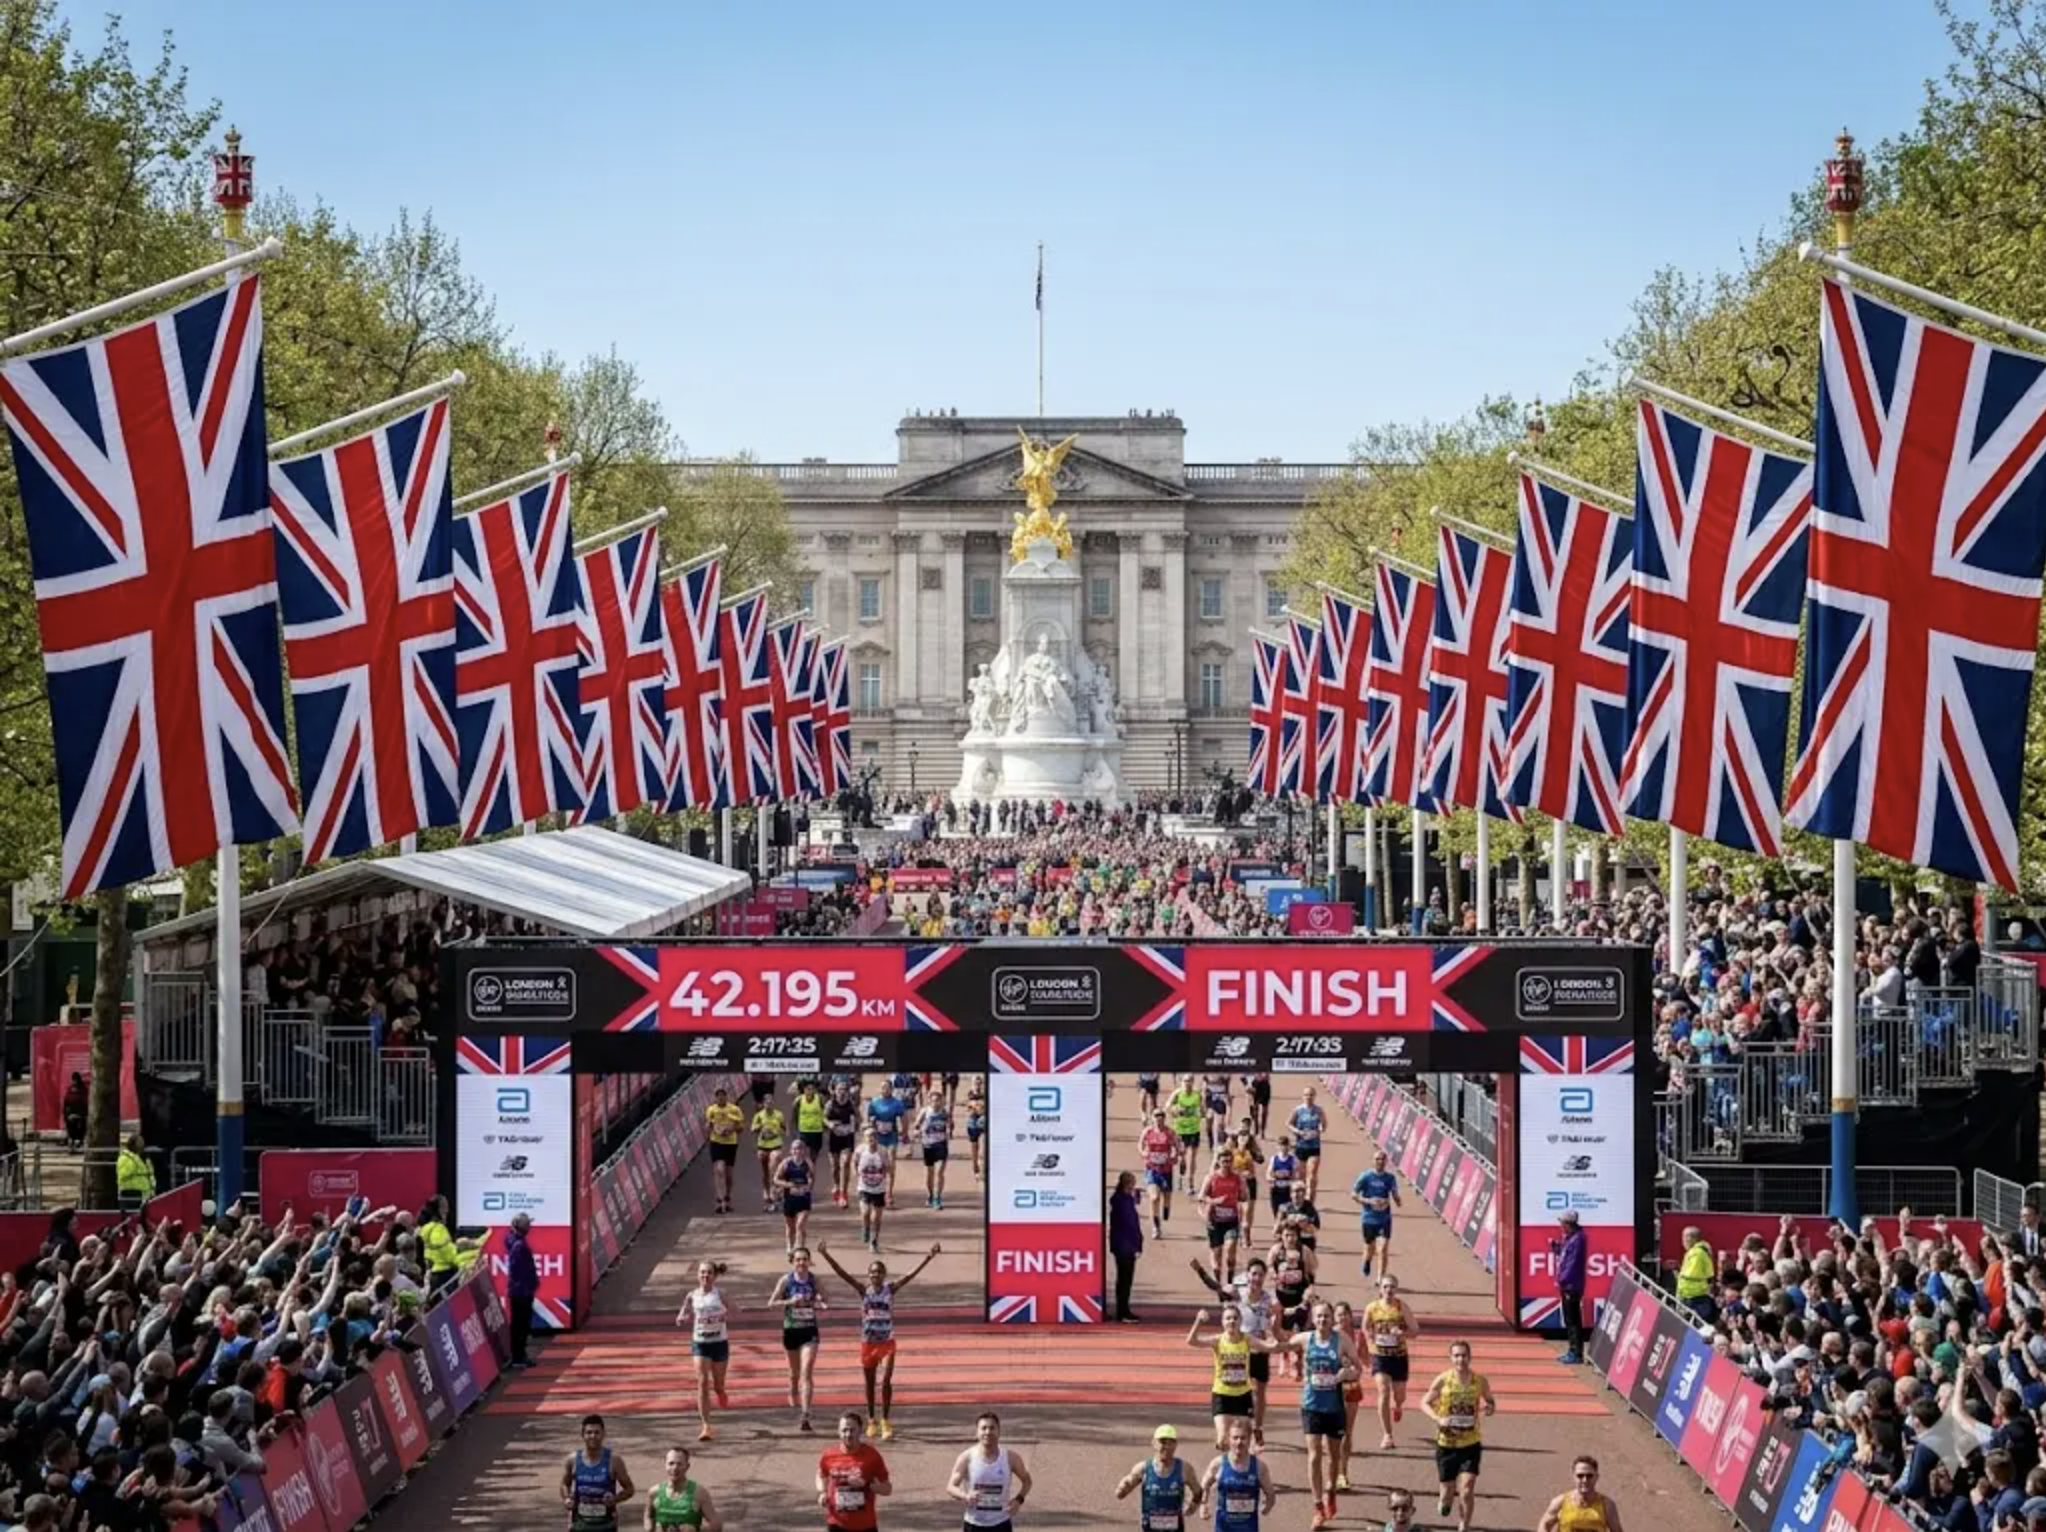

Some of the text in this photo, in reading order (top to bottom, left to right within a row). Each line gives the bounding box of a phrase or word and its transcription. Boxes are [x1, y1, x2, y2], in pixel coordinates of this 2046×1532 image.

[669, 969, 895, 1017] 42.195 KM
[1207, 969, 1407, 1017] FINISH
[996, 1249, 1094, 1273] FINISH
[1529, 1252, 1627, 1277] FISH
